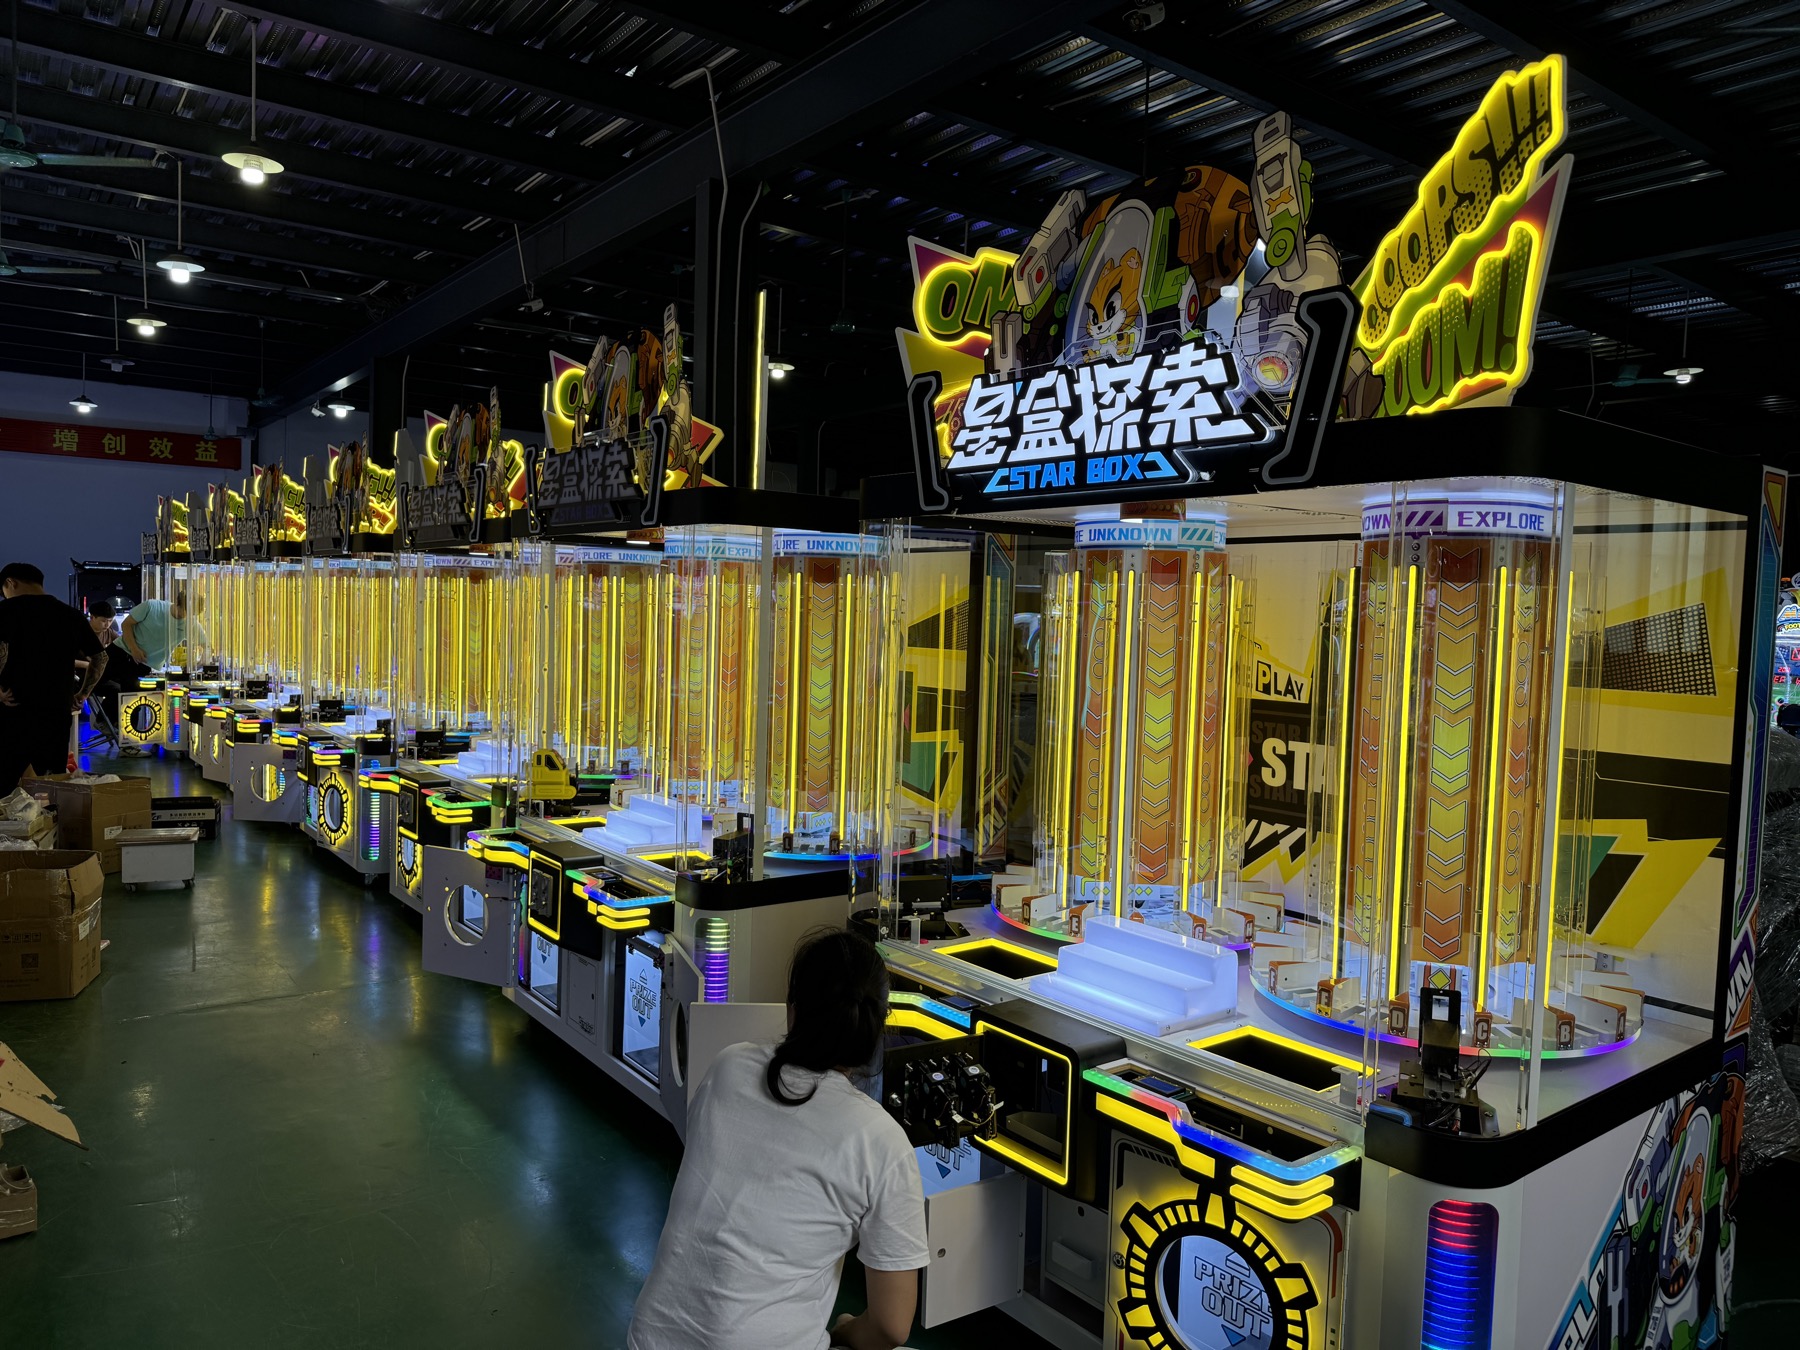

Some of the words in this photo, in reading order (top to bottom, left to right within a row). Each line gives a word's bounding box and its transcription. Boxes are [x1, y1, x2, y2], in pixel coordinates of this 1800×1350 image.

[947, 343, 1256, 470] 星盒探索
[53, 429, 218, 463] 增创效益
[1009, 460, 1076, 491] STAR
[1087, 453, 1145, 484] BOX
[1089, 527, 1172, 542] UNKNOWN
[1457, 510, 1545, 532] EXPLORE
[1256, 660, 1304, 701] PLAY
[629, 978, 657, 1008] PRIZE
[632, 995, 653, 1020] OUT
[1476, 1022, 1488, 1040] C
[1560, 1024, 1571, 1043] B
[1618, 1016, 1625, 1034] A
[1201, 1285, 1270, 1340] OUT
